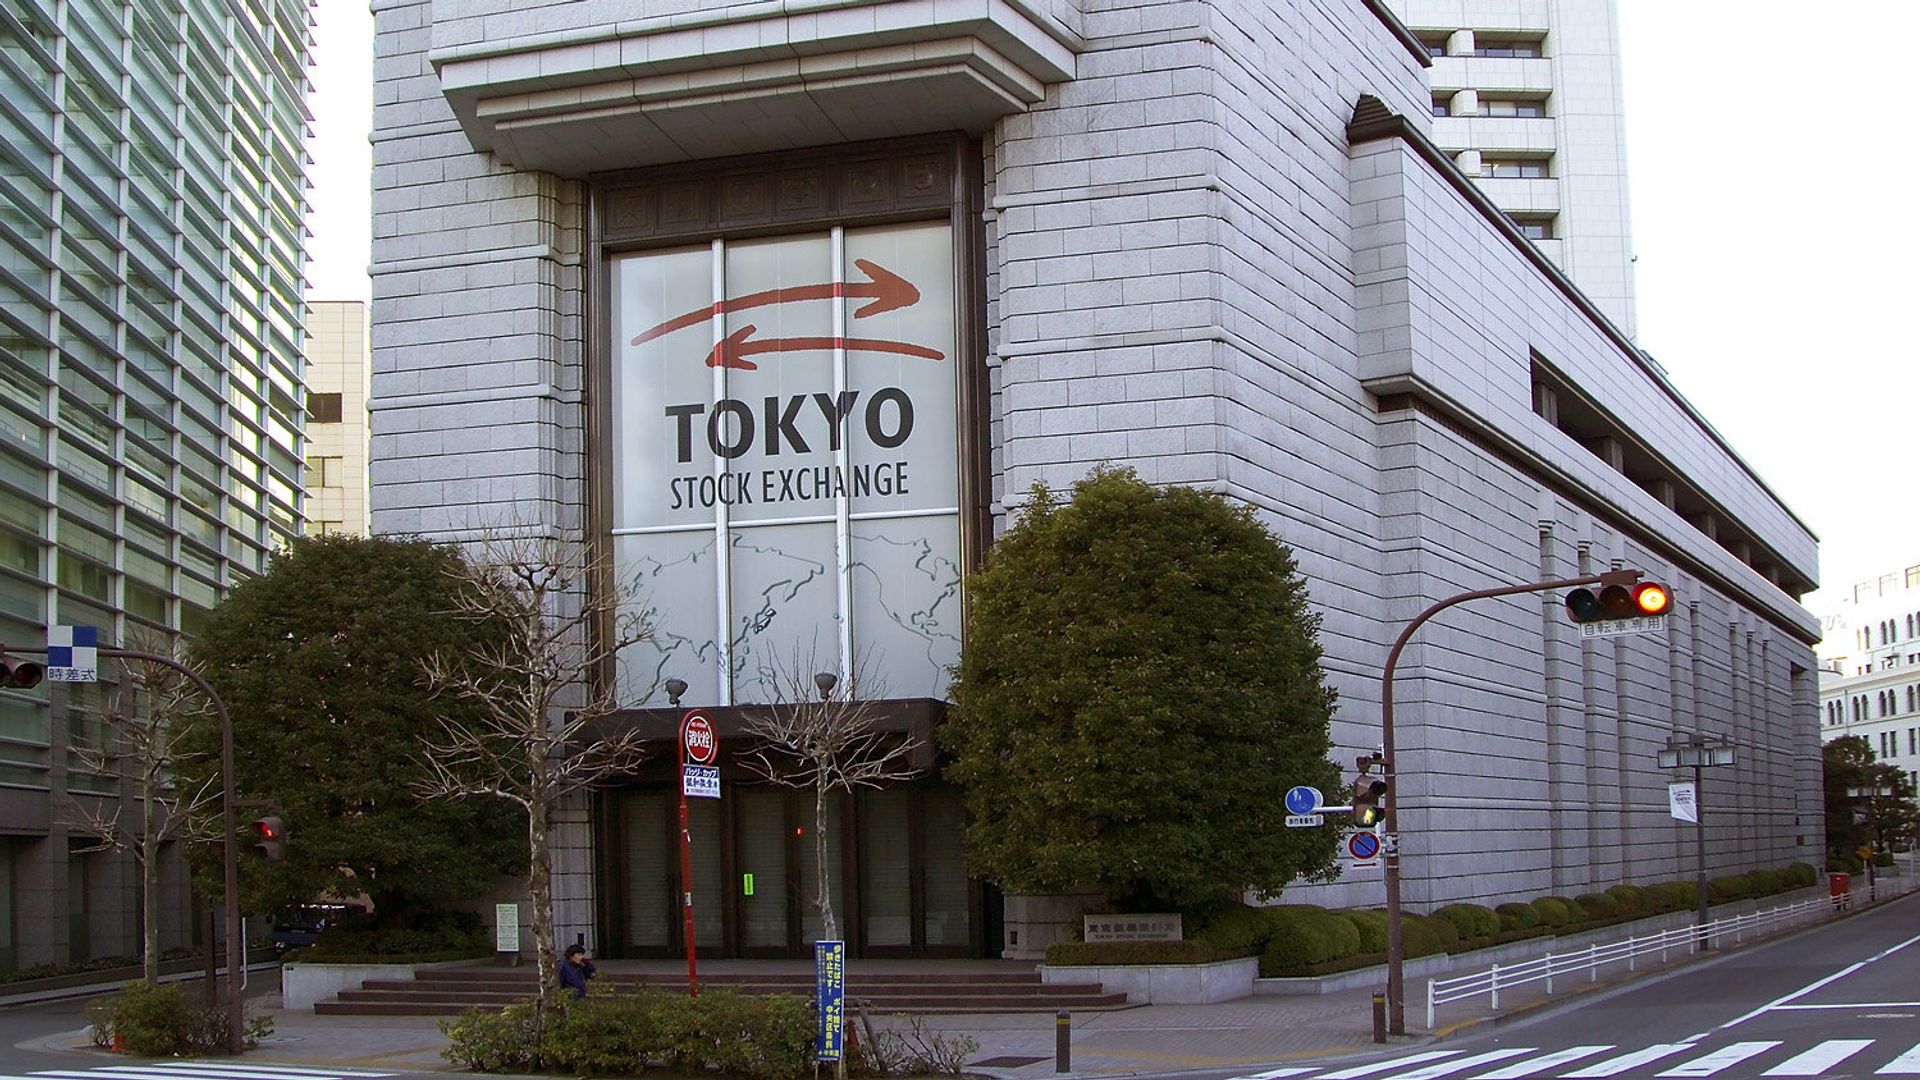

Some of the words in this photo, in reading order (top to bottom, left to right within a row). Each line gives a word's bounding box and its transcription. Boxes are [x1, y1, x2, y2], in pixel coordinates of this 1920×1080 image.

[665, 387, 914, 463] TOKYO
[671, 472, 752, 510] STOCK
[763, 462, 909, 503] EXCHANGE
[1584, 616, 1660, 635] 自転車専用
[48, 668, 95, 681] 時差式
[688, 730, 710, 748] 消火栓
